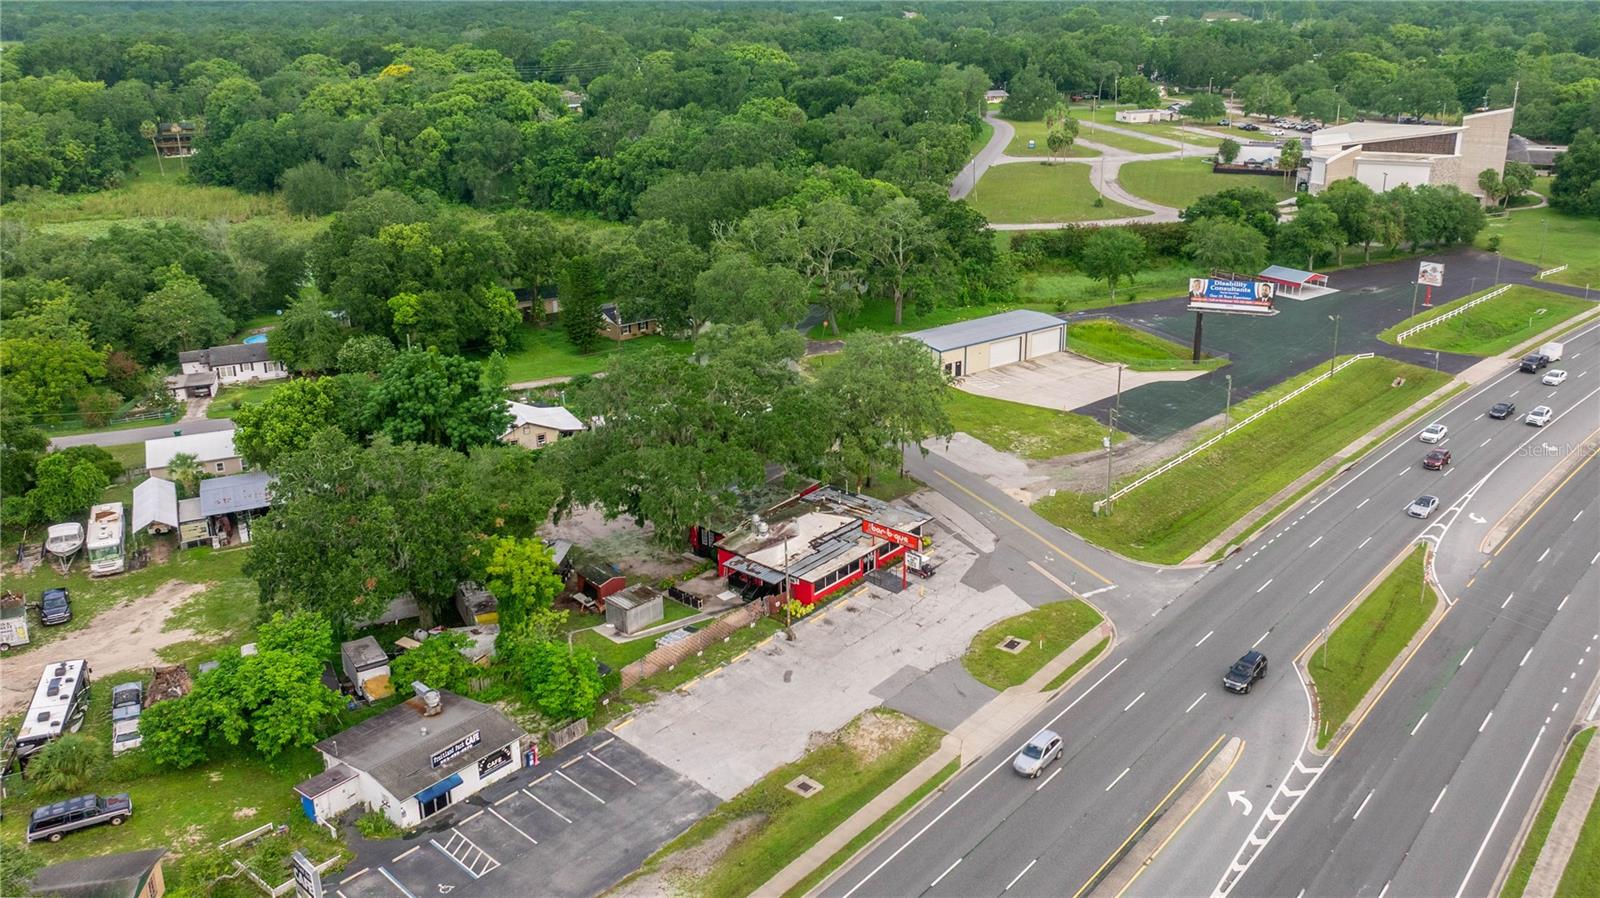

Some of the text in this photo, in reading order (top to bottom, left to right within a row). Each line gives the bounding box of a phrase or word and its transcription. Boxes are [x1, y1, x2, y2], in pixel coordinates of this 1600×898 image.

[1214, 279, 1247, 288] Disability
[1210, 285, 1251, 293] Consultants
[465, 732, 480, 746] CAFE
[486, 757, 503, 769] CAFE
